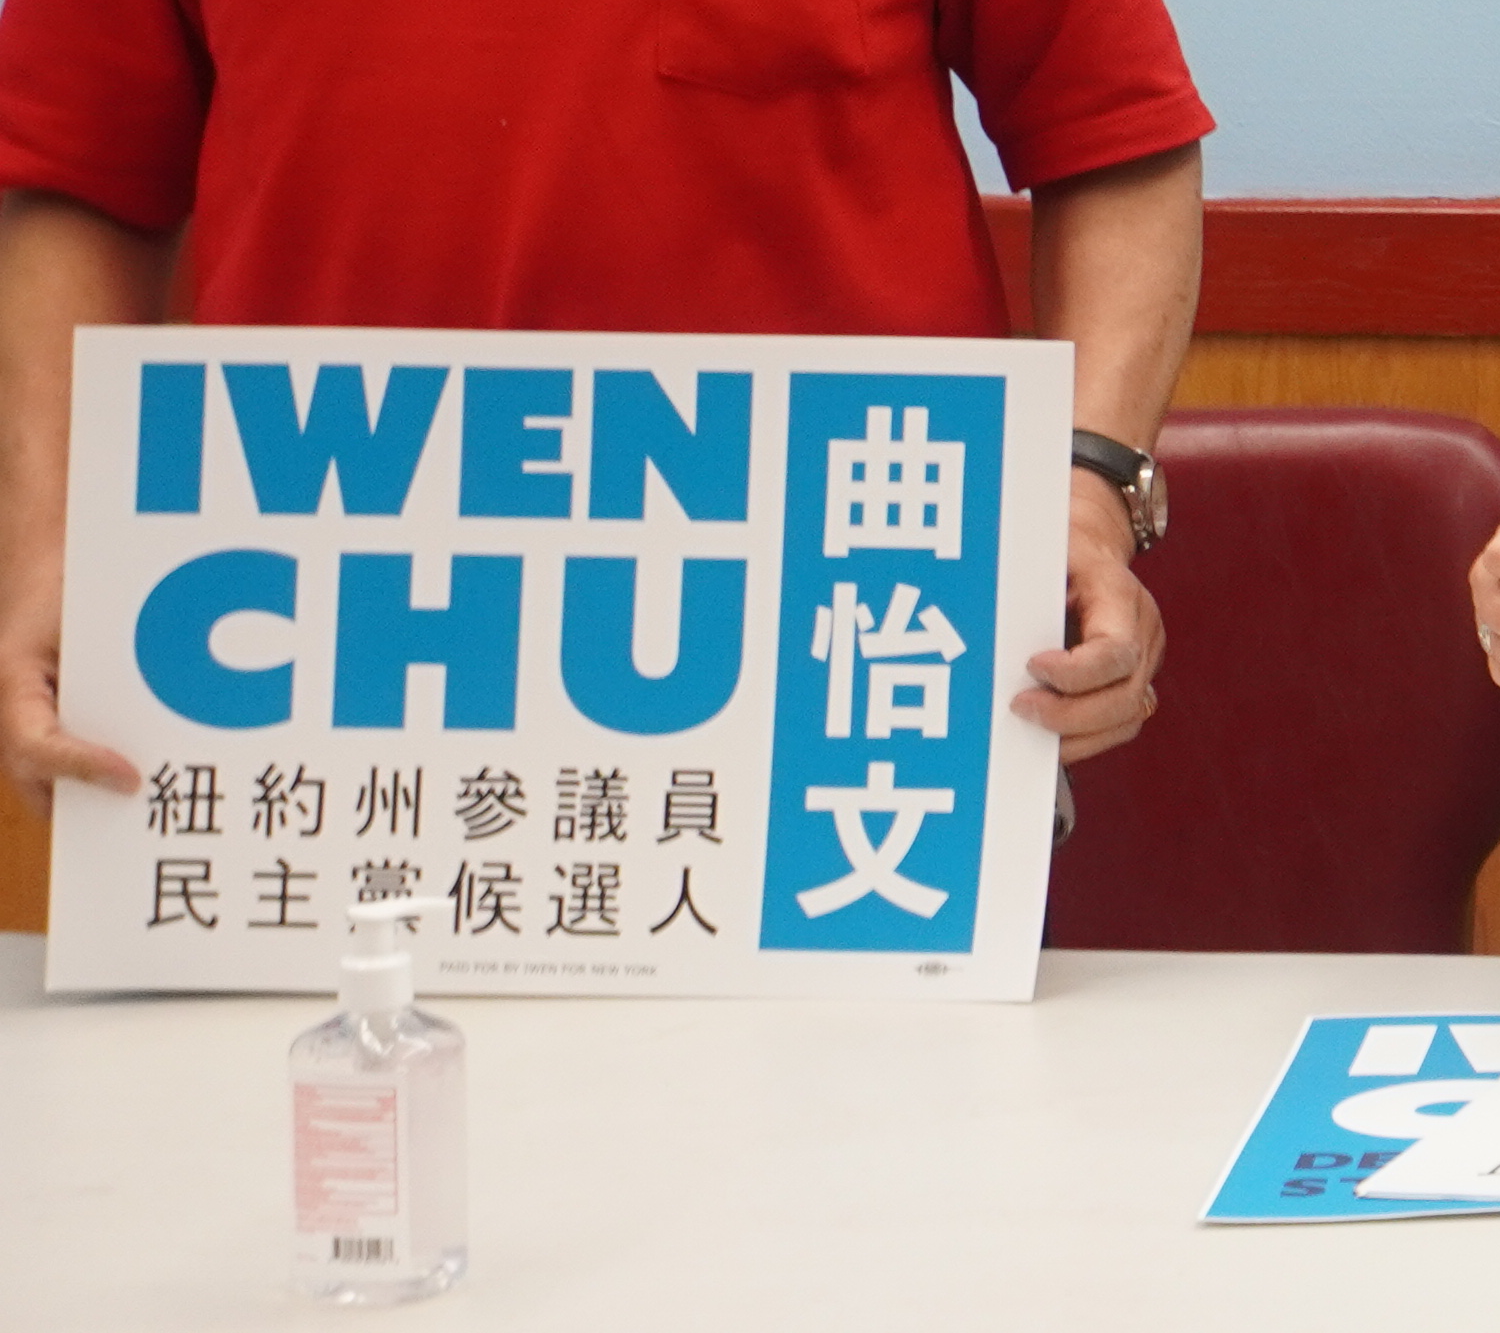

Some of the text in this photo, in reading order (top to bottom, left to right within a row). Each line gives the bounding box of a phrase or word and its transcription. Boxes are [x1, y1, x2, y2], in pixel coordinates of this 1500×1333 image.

[136, 363, 754, 523] IWEN
[134, 549, 748, 736] CHU
[795, 404, 967, 922] 曲怡文
[147, 762, 724, 845] 紐約州參議員
